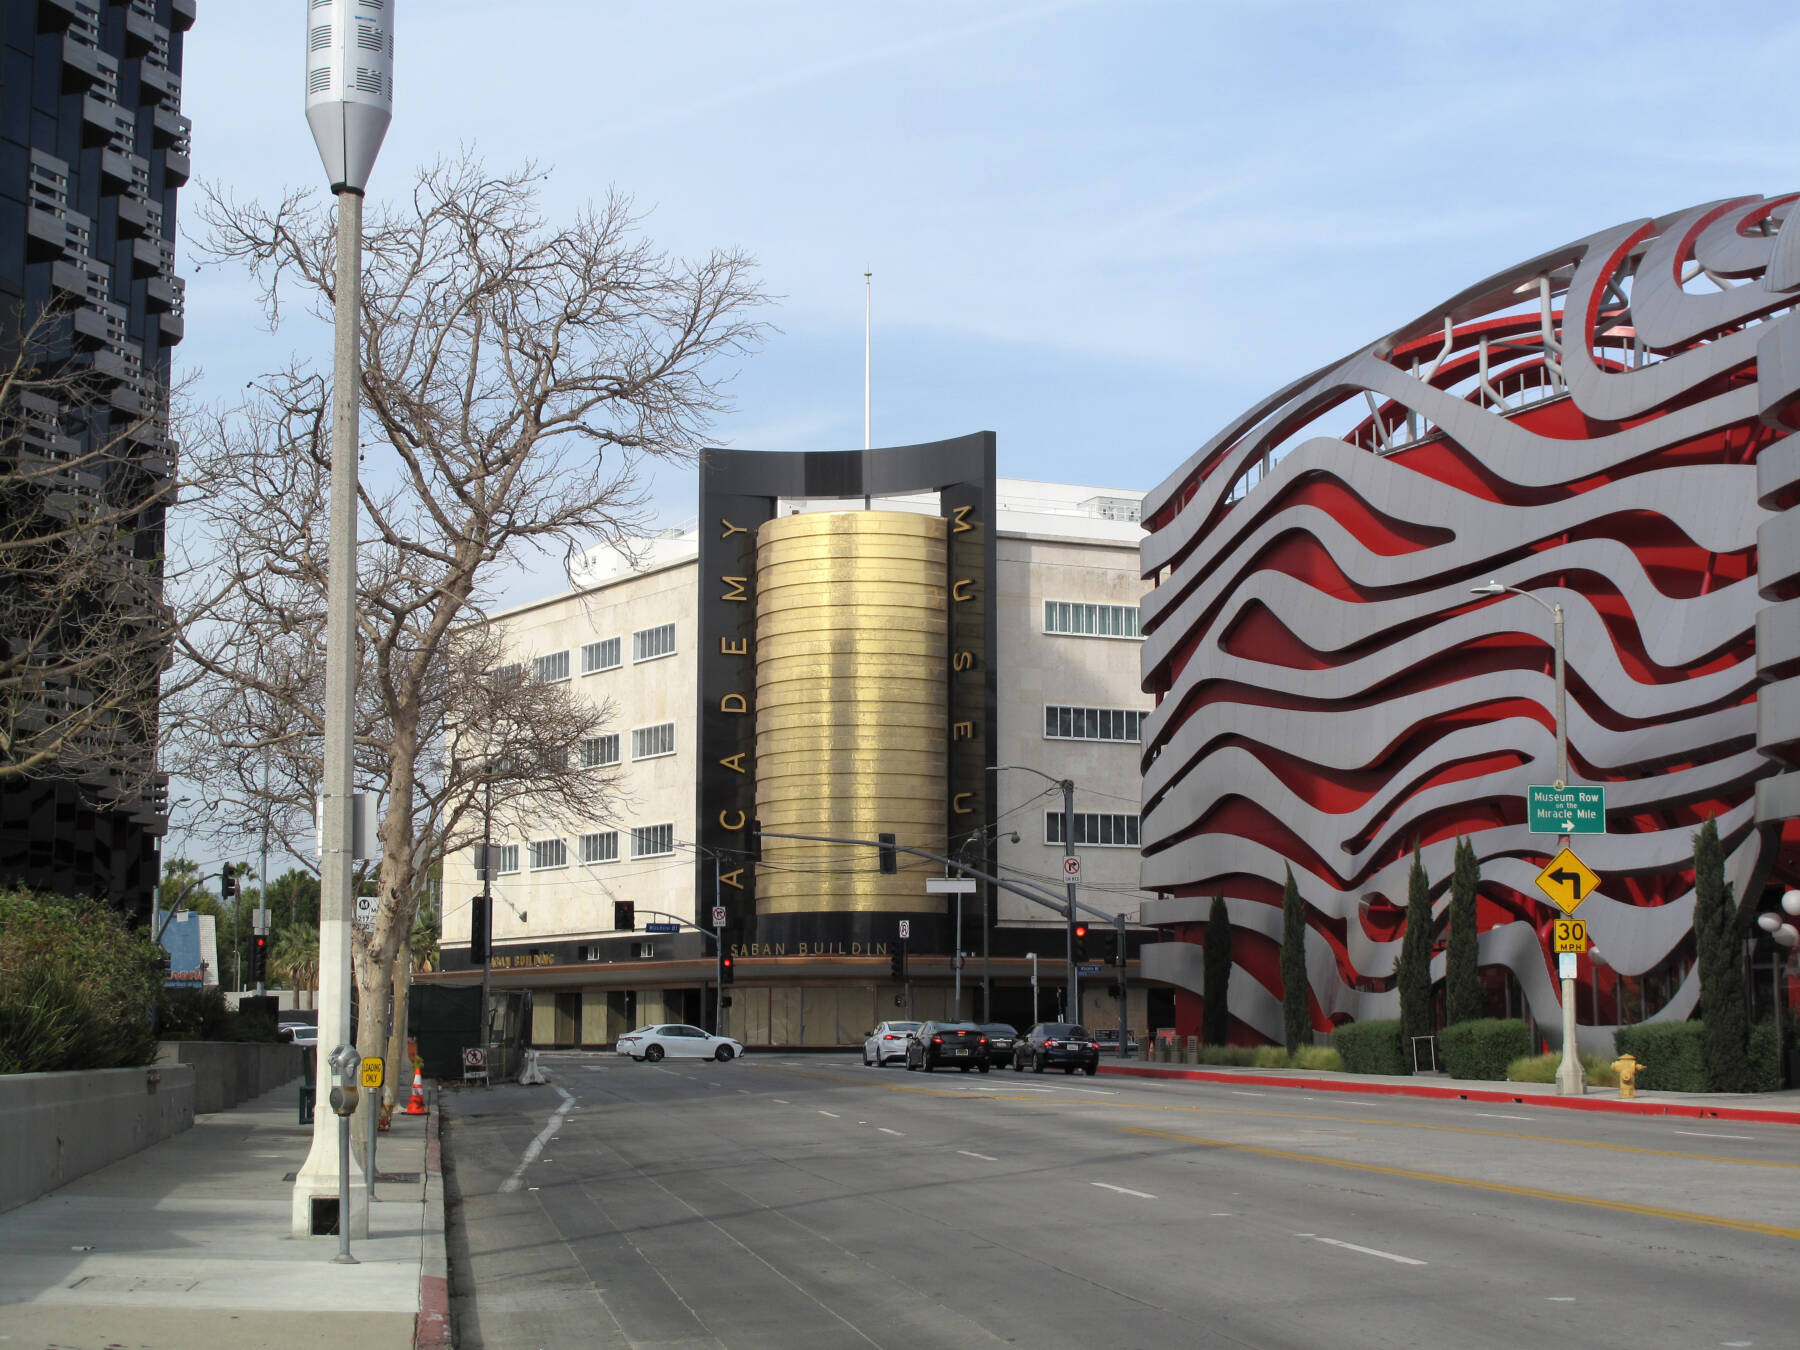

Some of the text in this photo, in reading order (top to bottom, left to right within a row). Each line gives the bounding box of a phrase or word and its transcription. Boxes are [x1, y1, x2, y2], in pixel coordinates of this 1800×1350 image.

[952, 505, 976, 876] MUSEU
[719, 519, 748, 890] ACADEMY
[1534, 791, 1599, 802] Museum Row
[1537, 809, 1597, 819] Miracle Mile
[1558, 922, 1584, 941] 30
[731, 942, 888, 957] SABAN BUILDIN
[1560, 943, 1582, 952] MPH
[366, 1073, 378, 1083] ONLY
